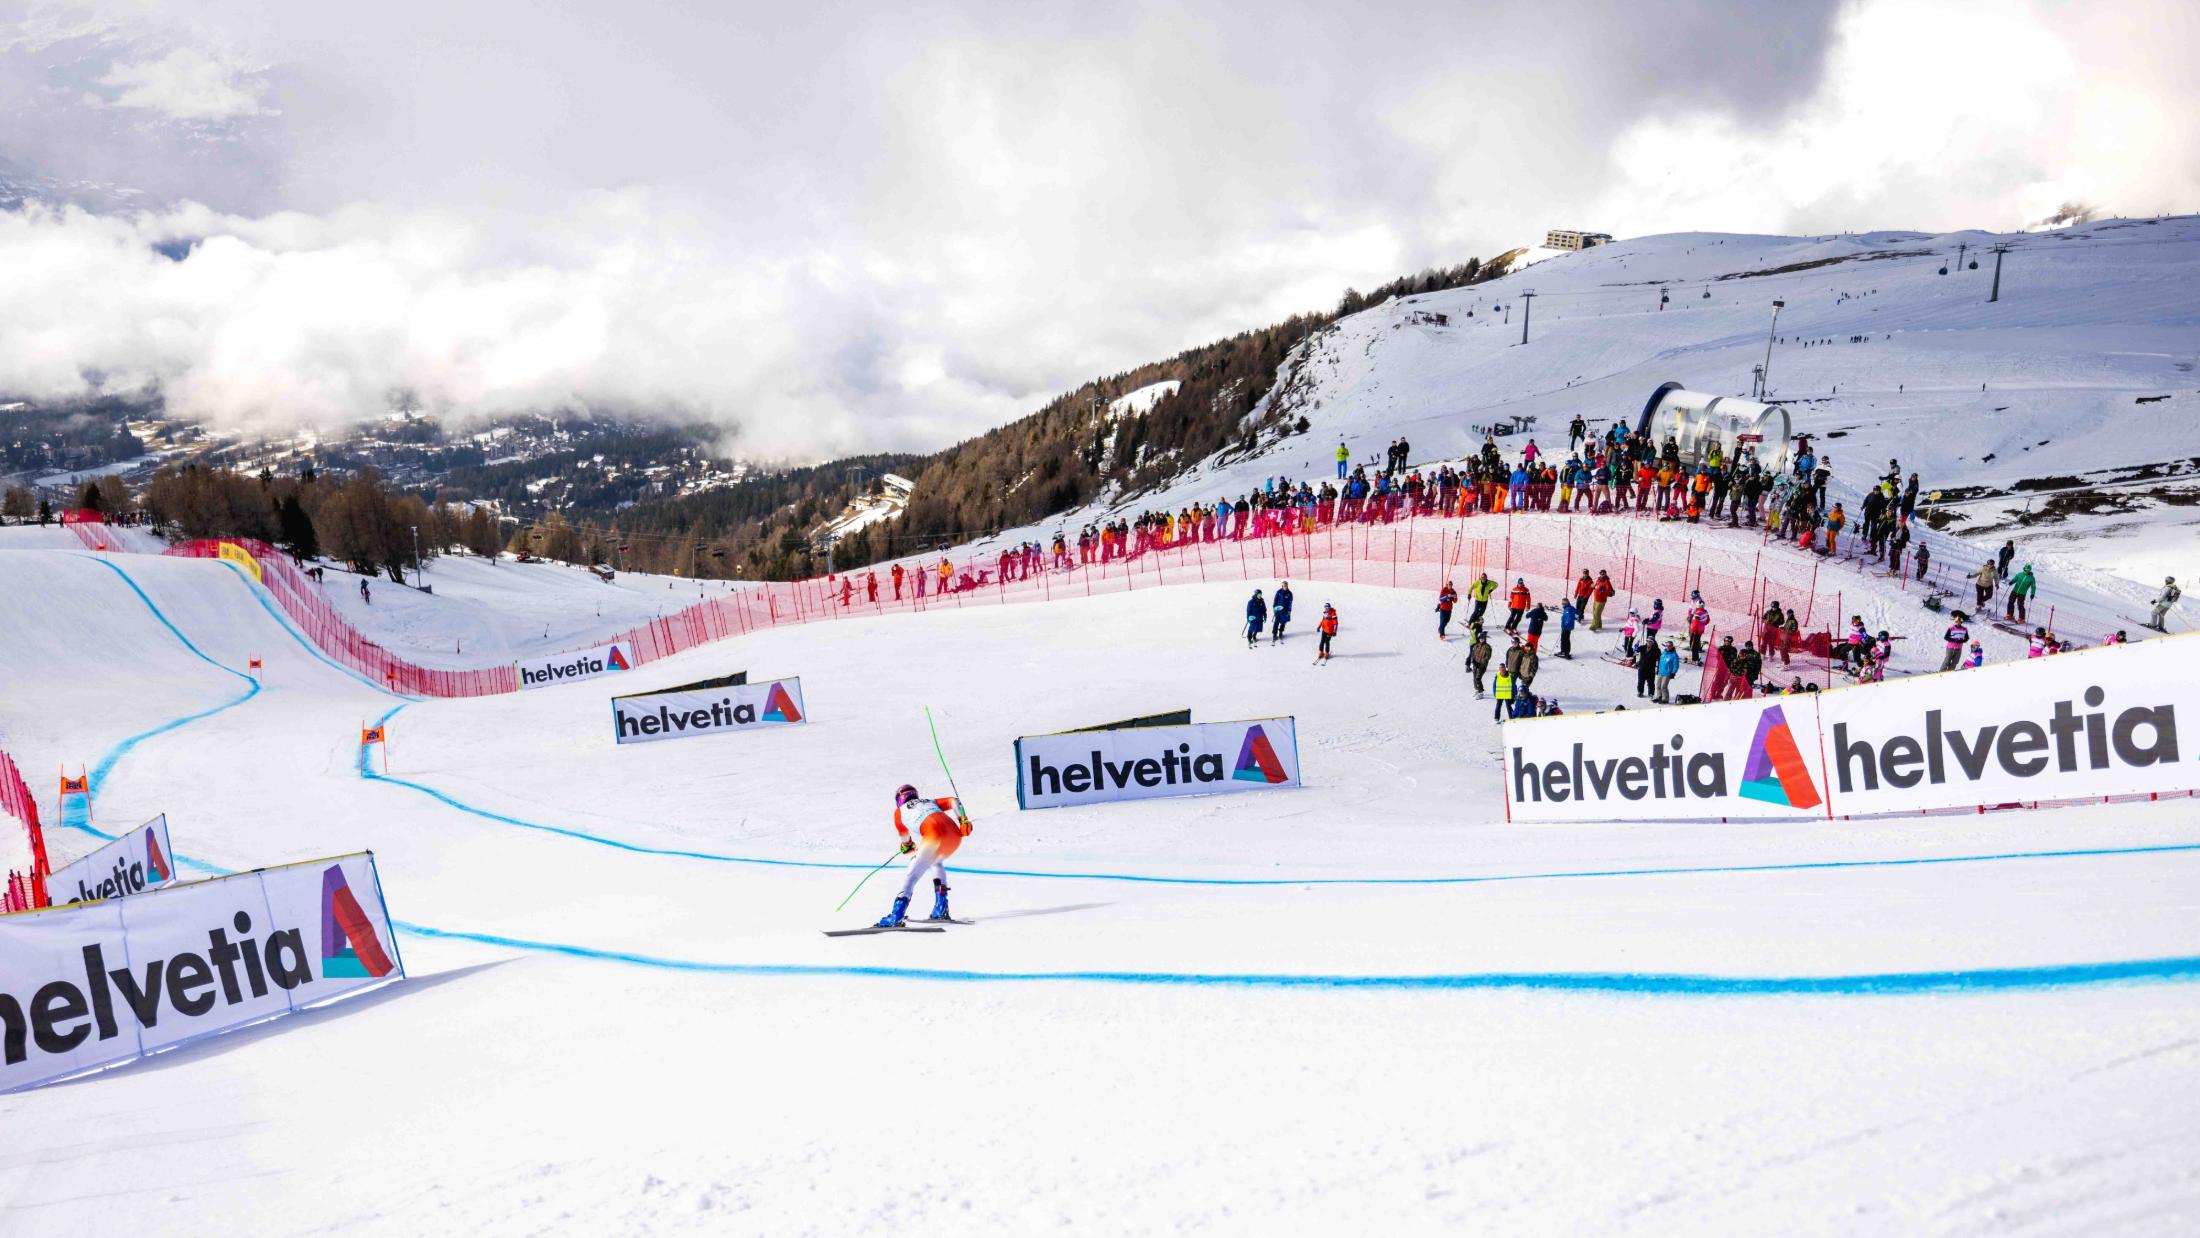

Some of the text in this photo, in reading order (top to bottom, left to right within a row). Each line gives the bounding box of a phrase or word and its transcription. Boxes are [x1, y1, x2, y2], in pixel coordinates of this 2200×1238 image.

[521, 656, 603, 684] helvetia
[617, 698, 756, 737] helvetia
[1834, 686, 2180, 793] helvetia
[1030, 743, 1224, 796] helvetia
[1514, 734, 1727, 803] helvetia
[48, 856, 146, 906] lvetia
